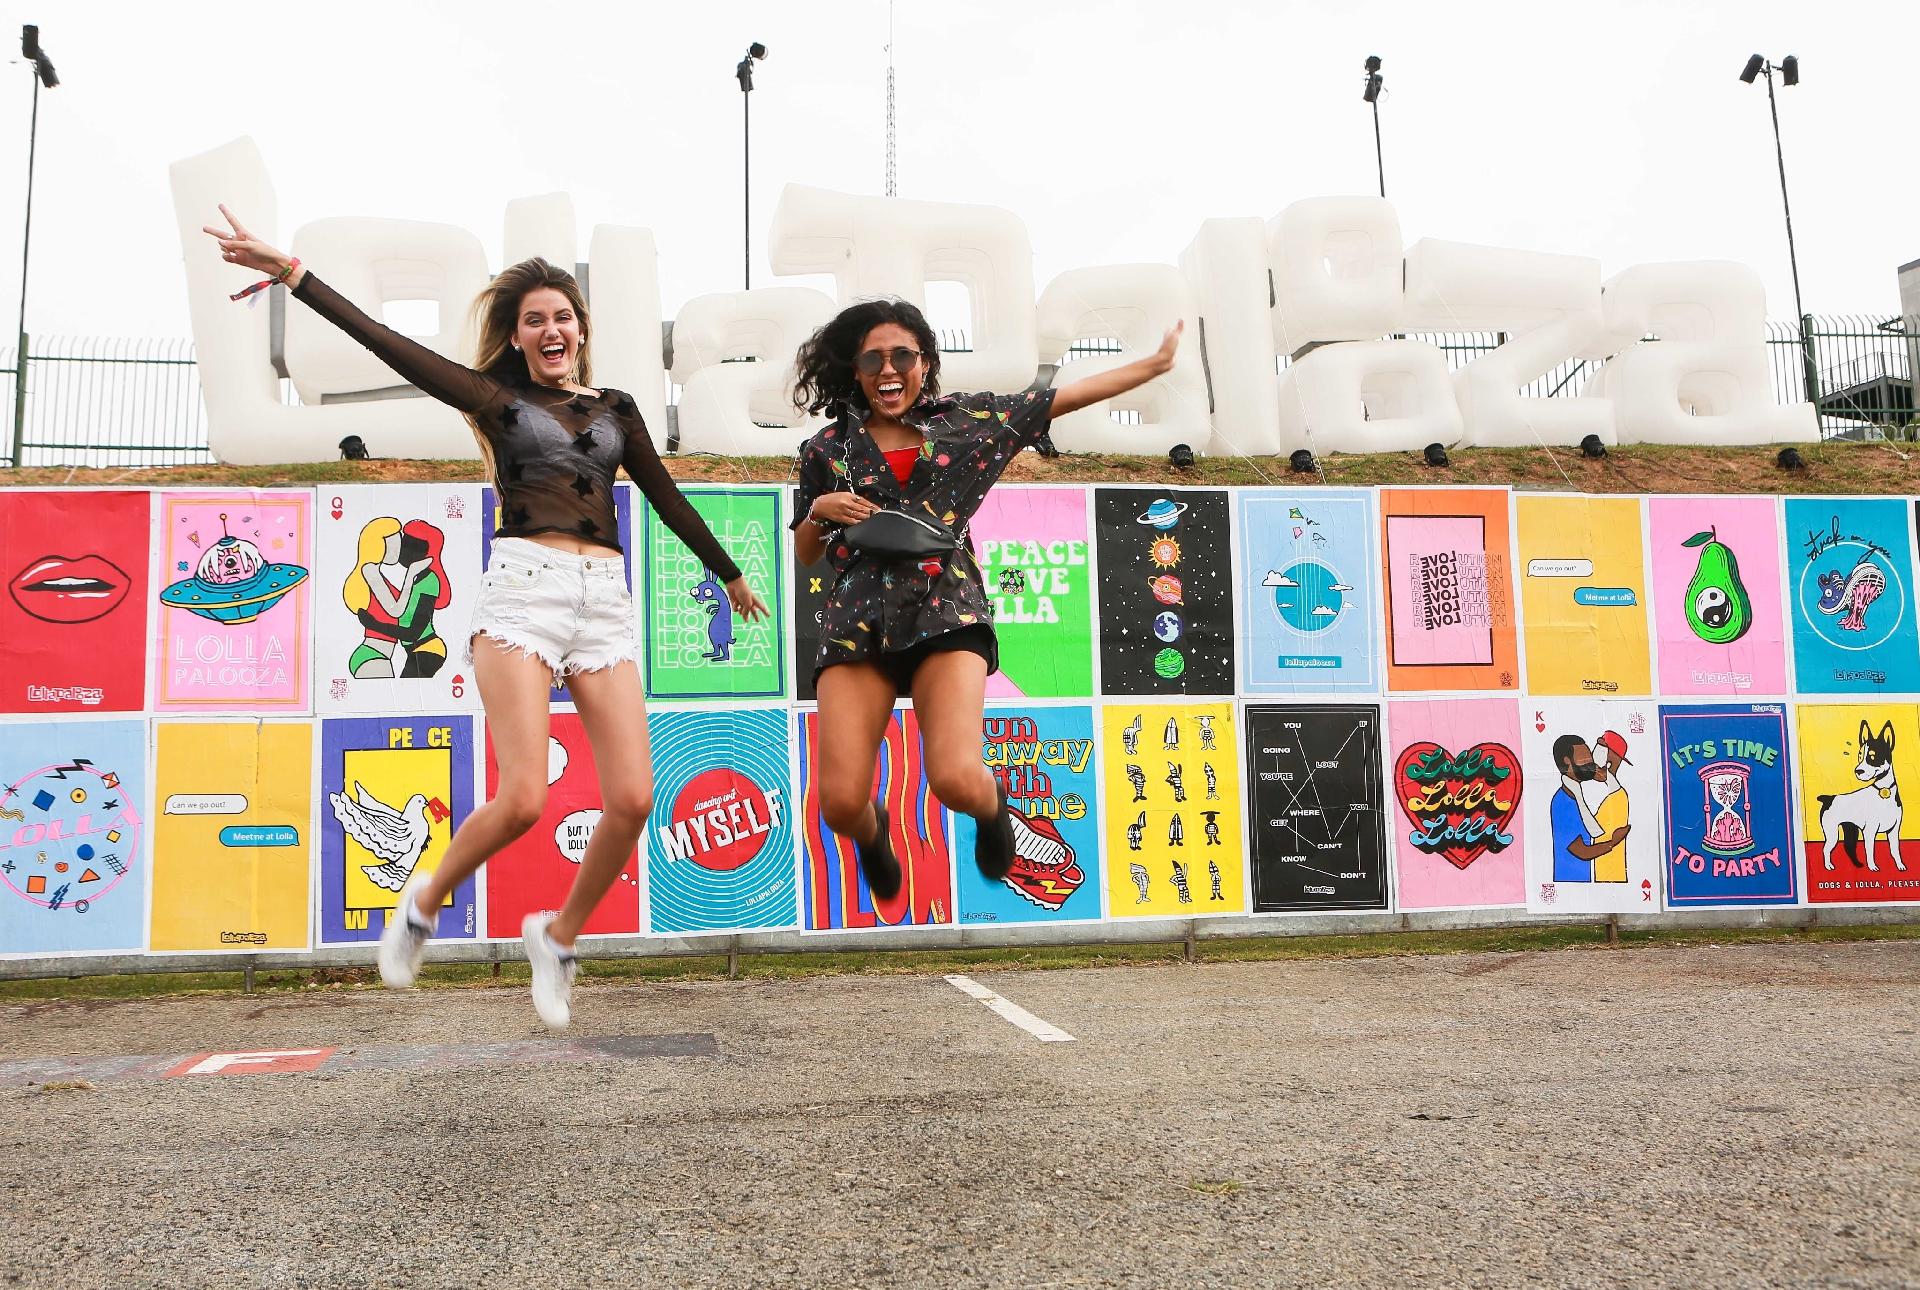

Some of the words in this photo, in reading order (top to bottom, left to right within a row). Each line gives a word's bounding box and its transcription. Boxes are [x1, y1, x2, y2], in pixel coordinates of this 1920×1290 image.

[331, 497, 343, 509] Q
[656, 520, 768, 542] LLLA
[980, 539, 1086, 566] PEACE
[176, 634, 288, 664] LOLLA
[175, 666, 289, 687] PALOOZA
[983, 717, 1038, 743] un
[1359, 720, 1368, 728] IF
[1535, 711, 1544, 722] K
[982, 739, 1095, 773] away
[1316, 760, 1339, 768] LOST
[1406, 748, 1510, 779] Lolla
[1672, 740, 1717, 769] IT'S
[1723, 739, 1778, 767] TIME
[992, 763, 1052, 798] ith
[199, 802, 209, 810] go
[694, 795, 723, 812] dancing
[1022, 793, 1087, 820] me
[1408, 781, 1512, 812] Lolla
[0, 806, 143, 852] OLLA
[265, 833, 273, 841] at
[275, 832, 294, 841] Lolla
[567, 825, 583, 837] BUT
[658, 788, 784, 863] MYSELF
[1409, 814, 1514, 845] Lolla
[1674, 846, 1705, 874] TO
[1713, 848, 1782, 877] PARTY
[745, 879, 784, 906] LOLLAPALOOZA
